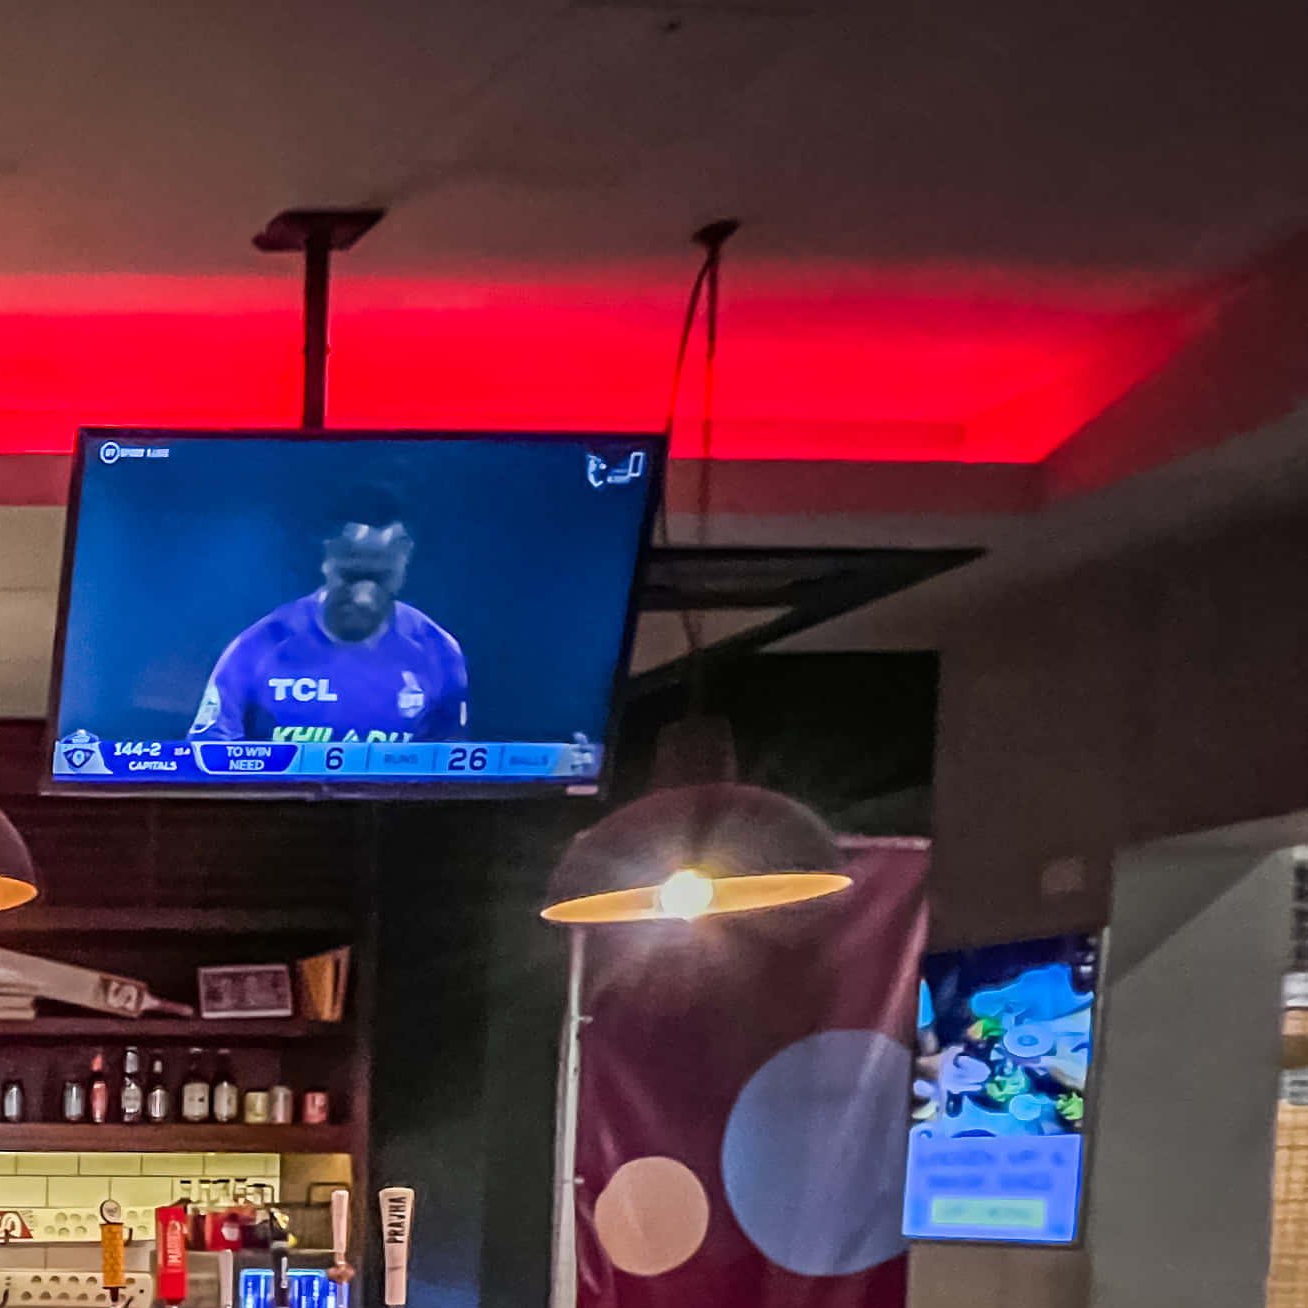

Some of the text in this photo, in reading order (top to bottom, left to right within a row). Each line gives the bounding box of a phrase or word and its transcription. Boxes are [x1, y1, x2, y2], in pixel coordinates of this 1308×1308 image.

[268, 677, 338, 702] TCL
[113, 742, 162, 757] 144-2
[225, 745, 272, 758] TO WIN
[128, 760, 178, 771] CAPITALS
[228, 759, 265, 771] NEED
[325, 747, 345, 771] 6
[447, 747, 488, 771] 26
[386, 1196, 406, 1244] PRAVHA
